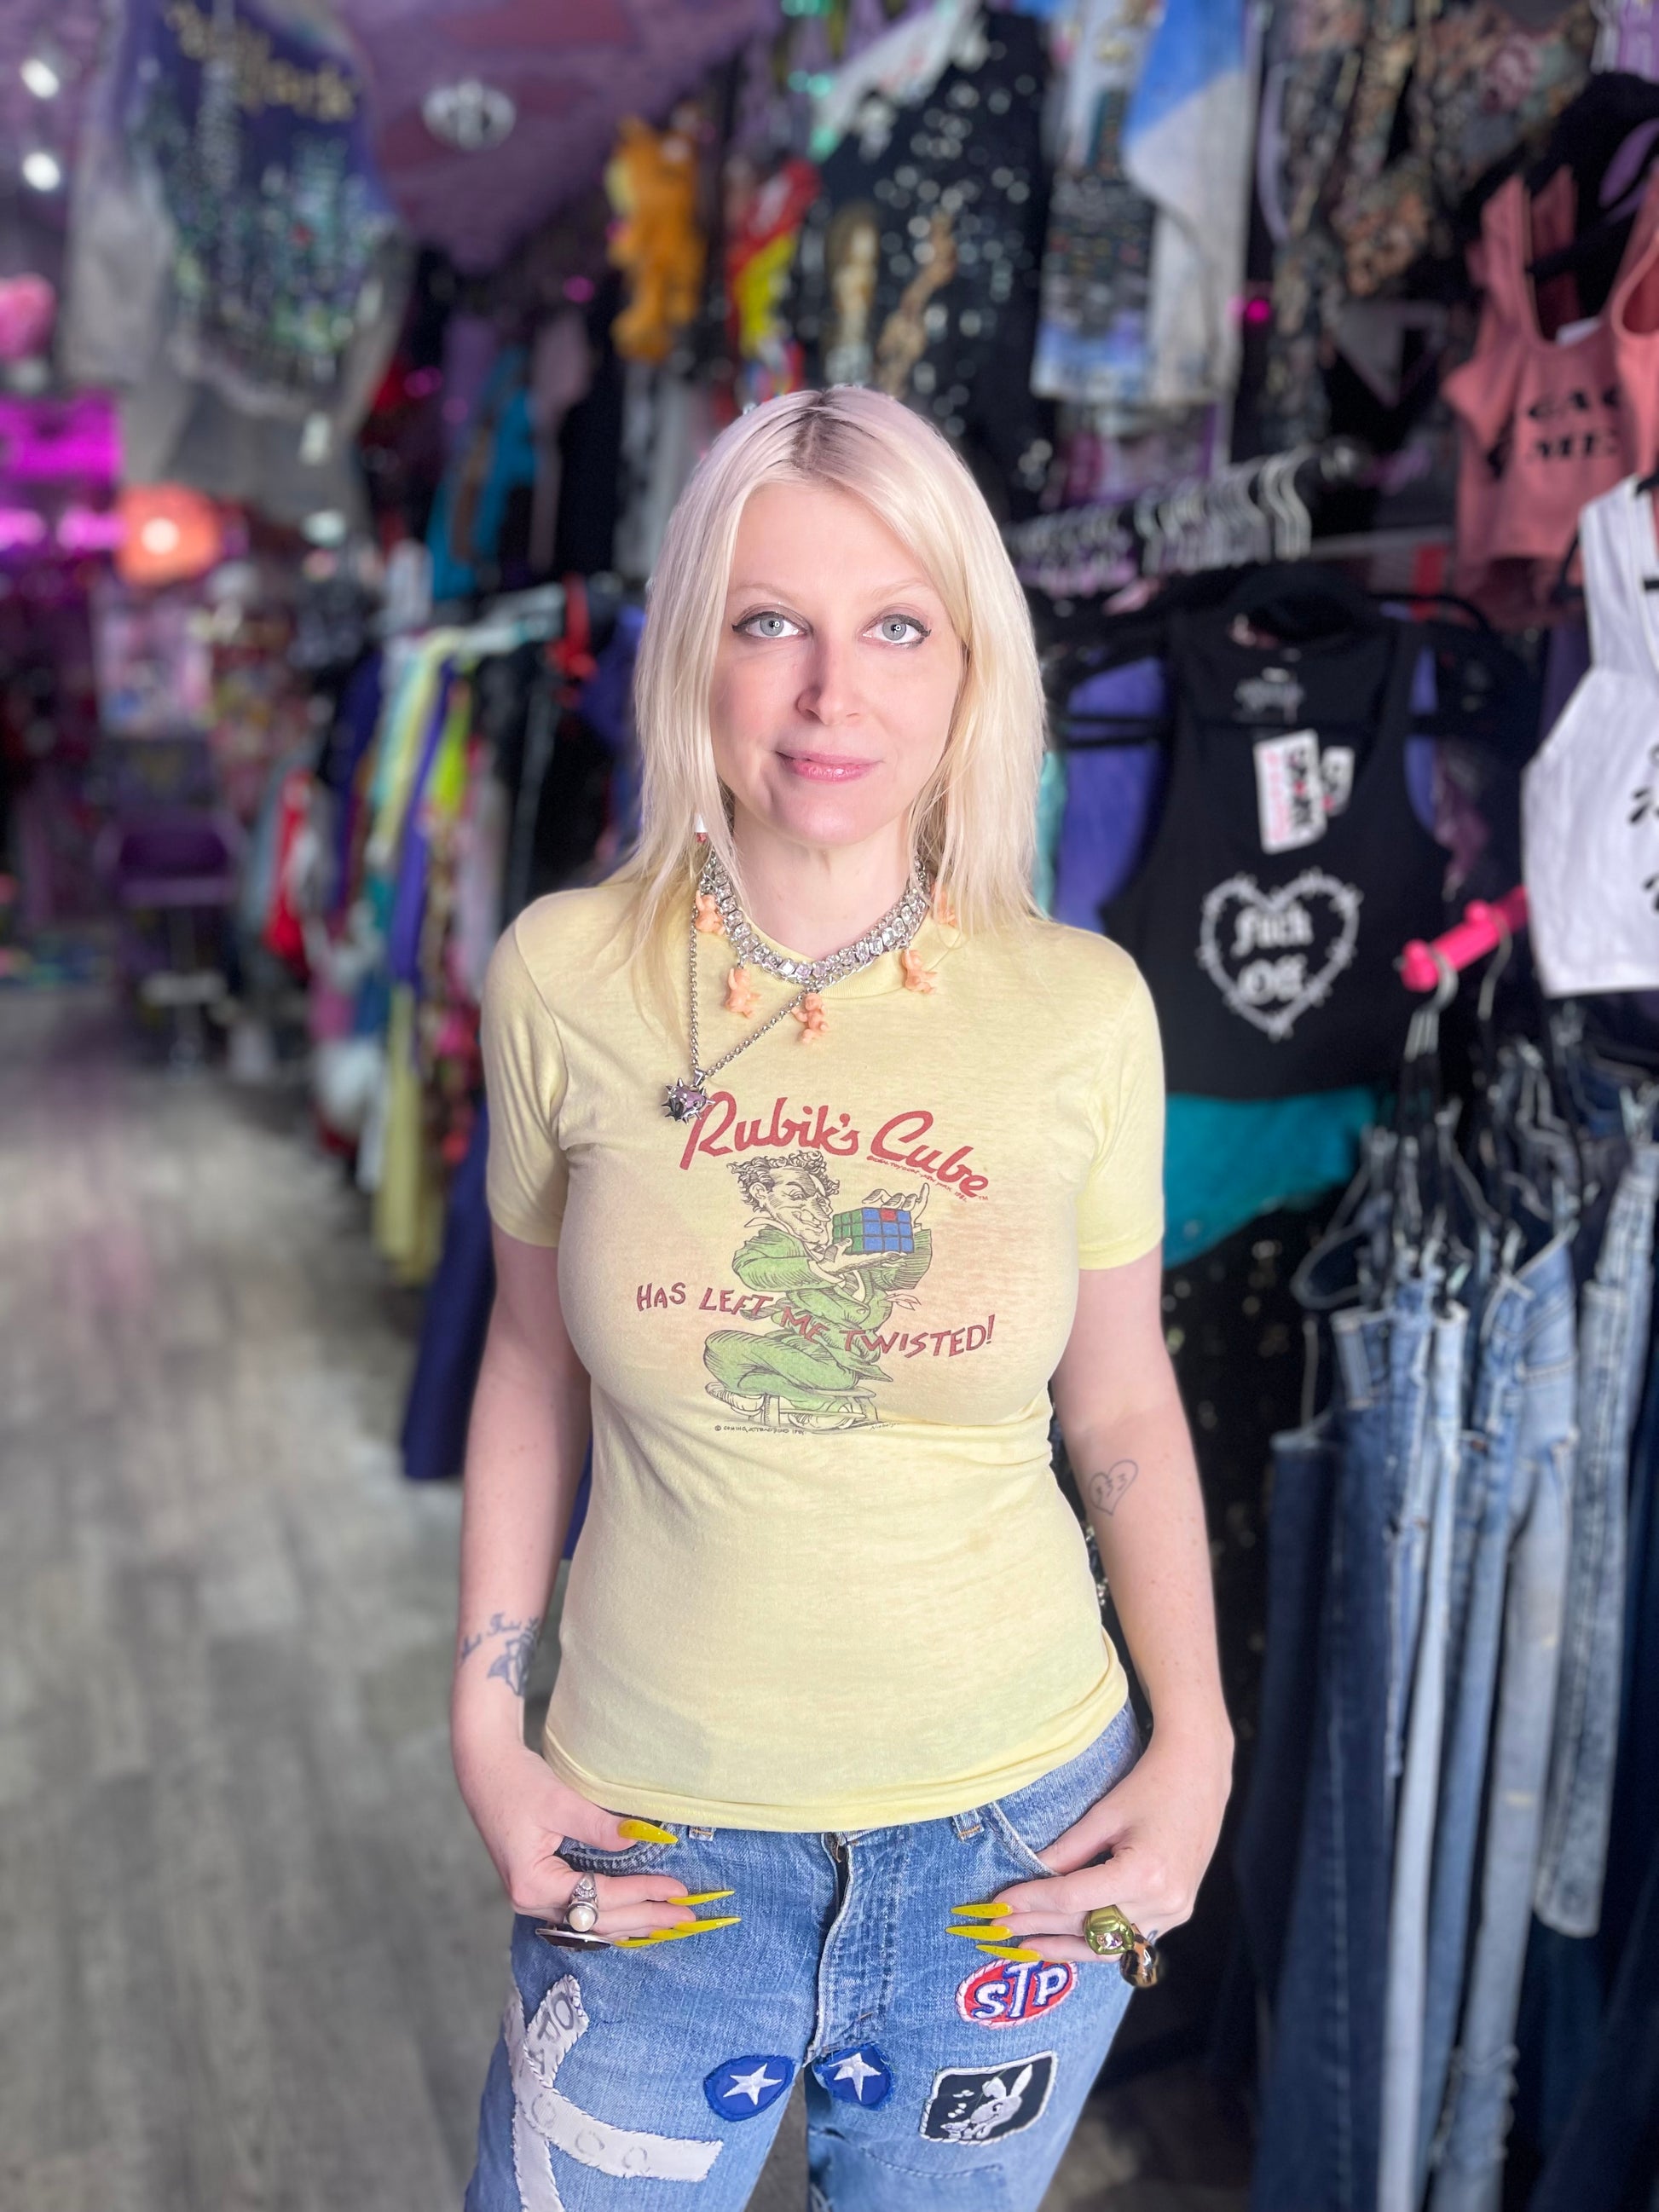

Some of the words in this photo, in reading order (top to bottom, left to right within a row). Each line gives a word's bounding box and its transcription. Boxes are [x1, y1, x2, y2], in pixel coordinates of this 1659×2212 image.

[679, 1091, 858, 1170] Rubik's
[870, 1111, 989, 1198] Cube
[636, 1281, 686, 1312] HAS
[699, 1287, 774, 1315] LEFT
[781, 1306, 830, 1344] ME
[839, 1314, 996, 1359] TWISTED!
[972, 1961, 1068, 2019] STP
